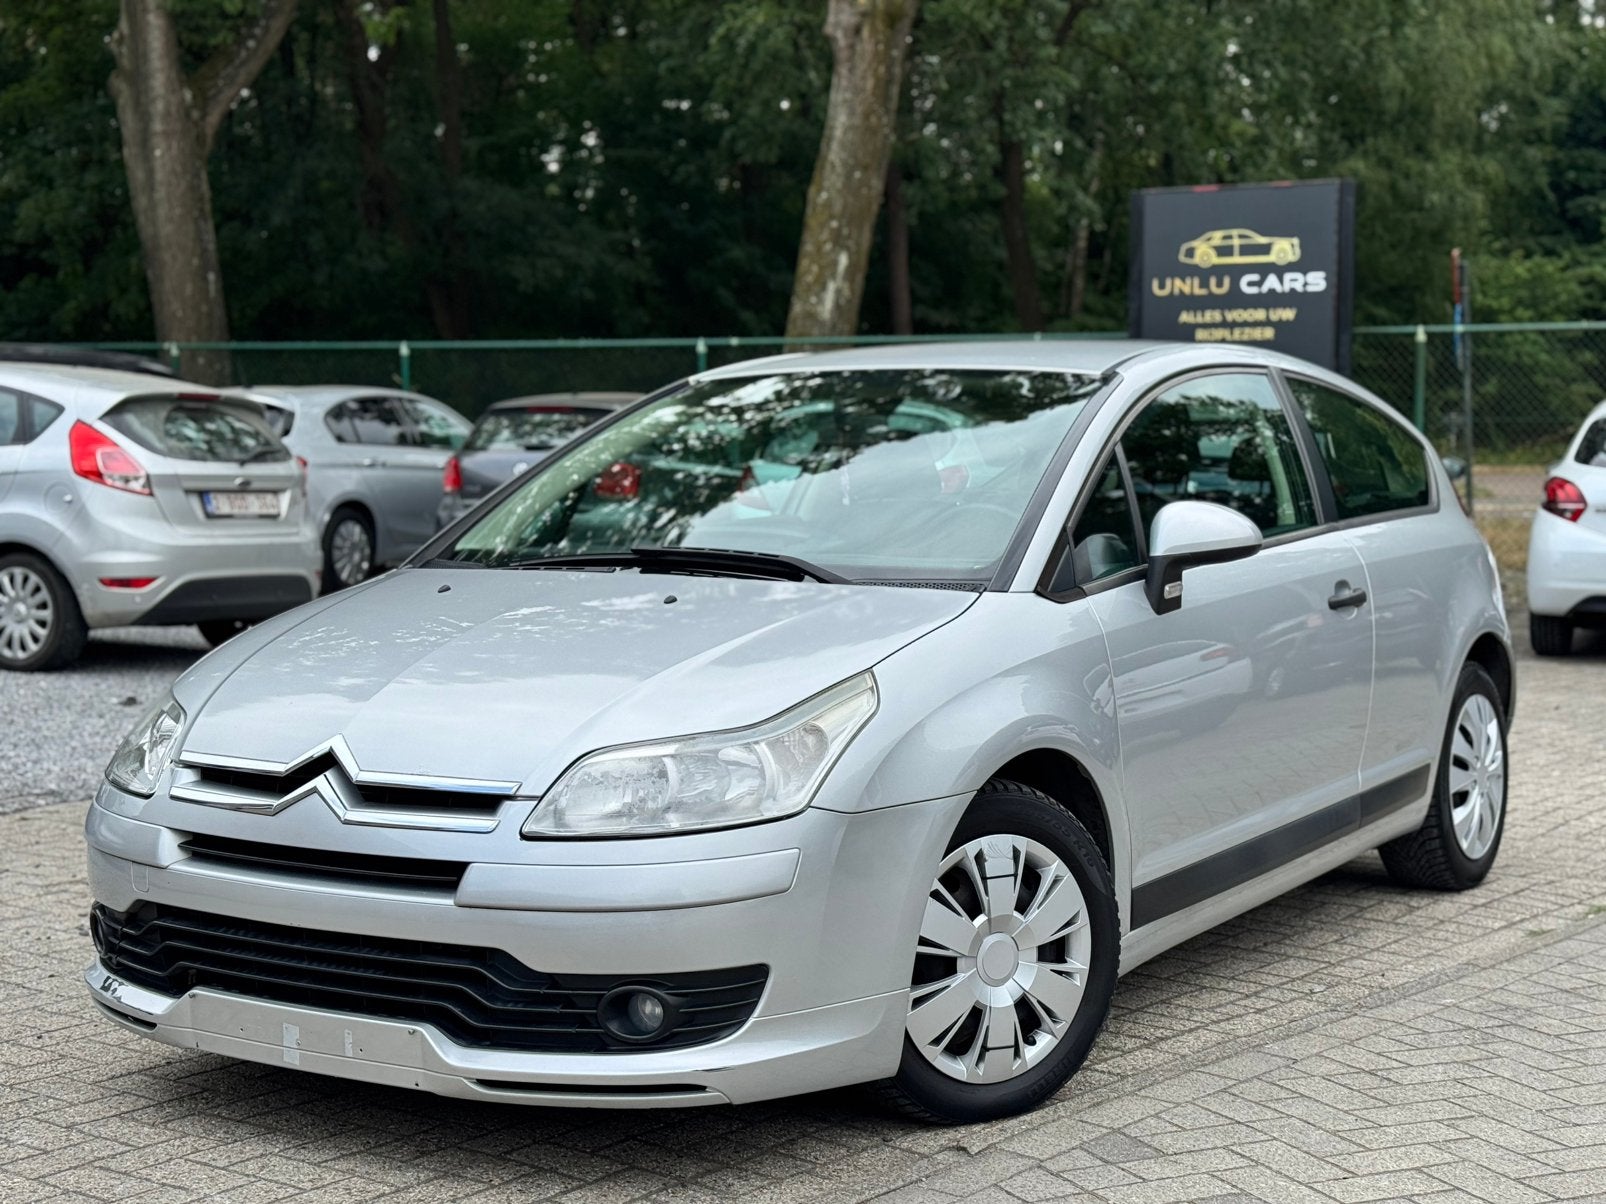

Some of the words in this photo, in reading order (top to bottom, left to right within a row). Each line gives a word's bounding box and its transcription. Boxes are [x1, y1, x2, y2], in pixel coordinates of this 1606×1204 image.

[1152, 275, 1231, 297] UNLU
[1239, 271, 1327, 294] CARS
[1178, 309, 1223, 324] ALLES
[1223, 308, 1267, 322] VOOR
[1269, 308, 1297, 322] UW
